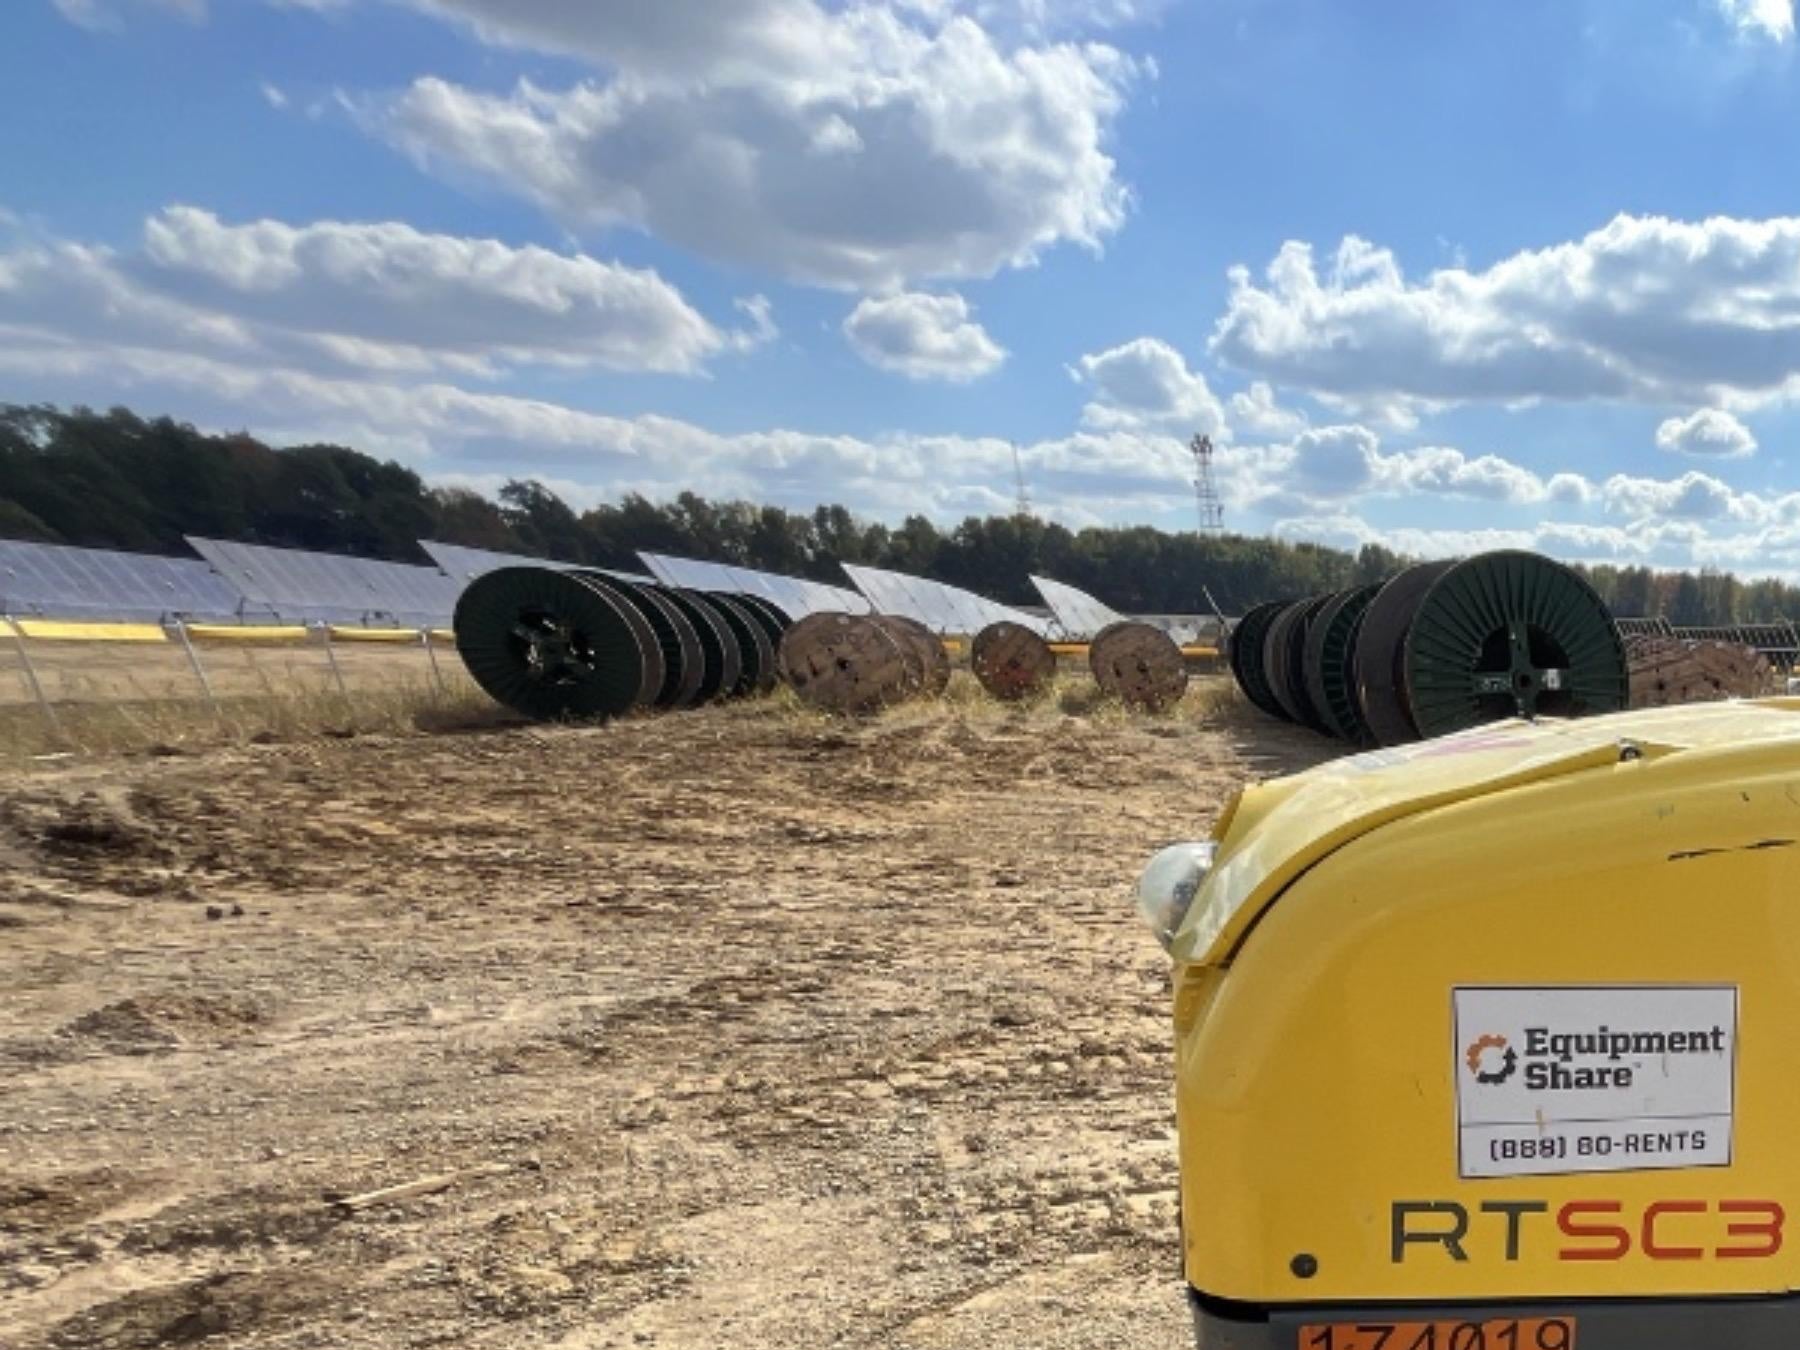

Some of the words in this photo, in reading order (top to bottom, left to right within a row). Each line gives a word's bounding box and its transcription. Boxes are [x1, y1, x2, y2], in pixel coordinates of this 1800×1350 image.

[1524, 1025, 1725, 1062] Equipment
[1524, 1061, 1633, 1090] Share
[1490, 1135, 1567, 1161] (888)
